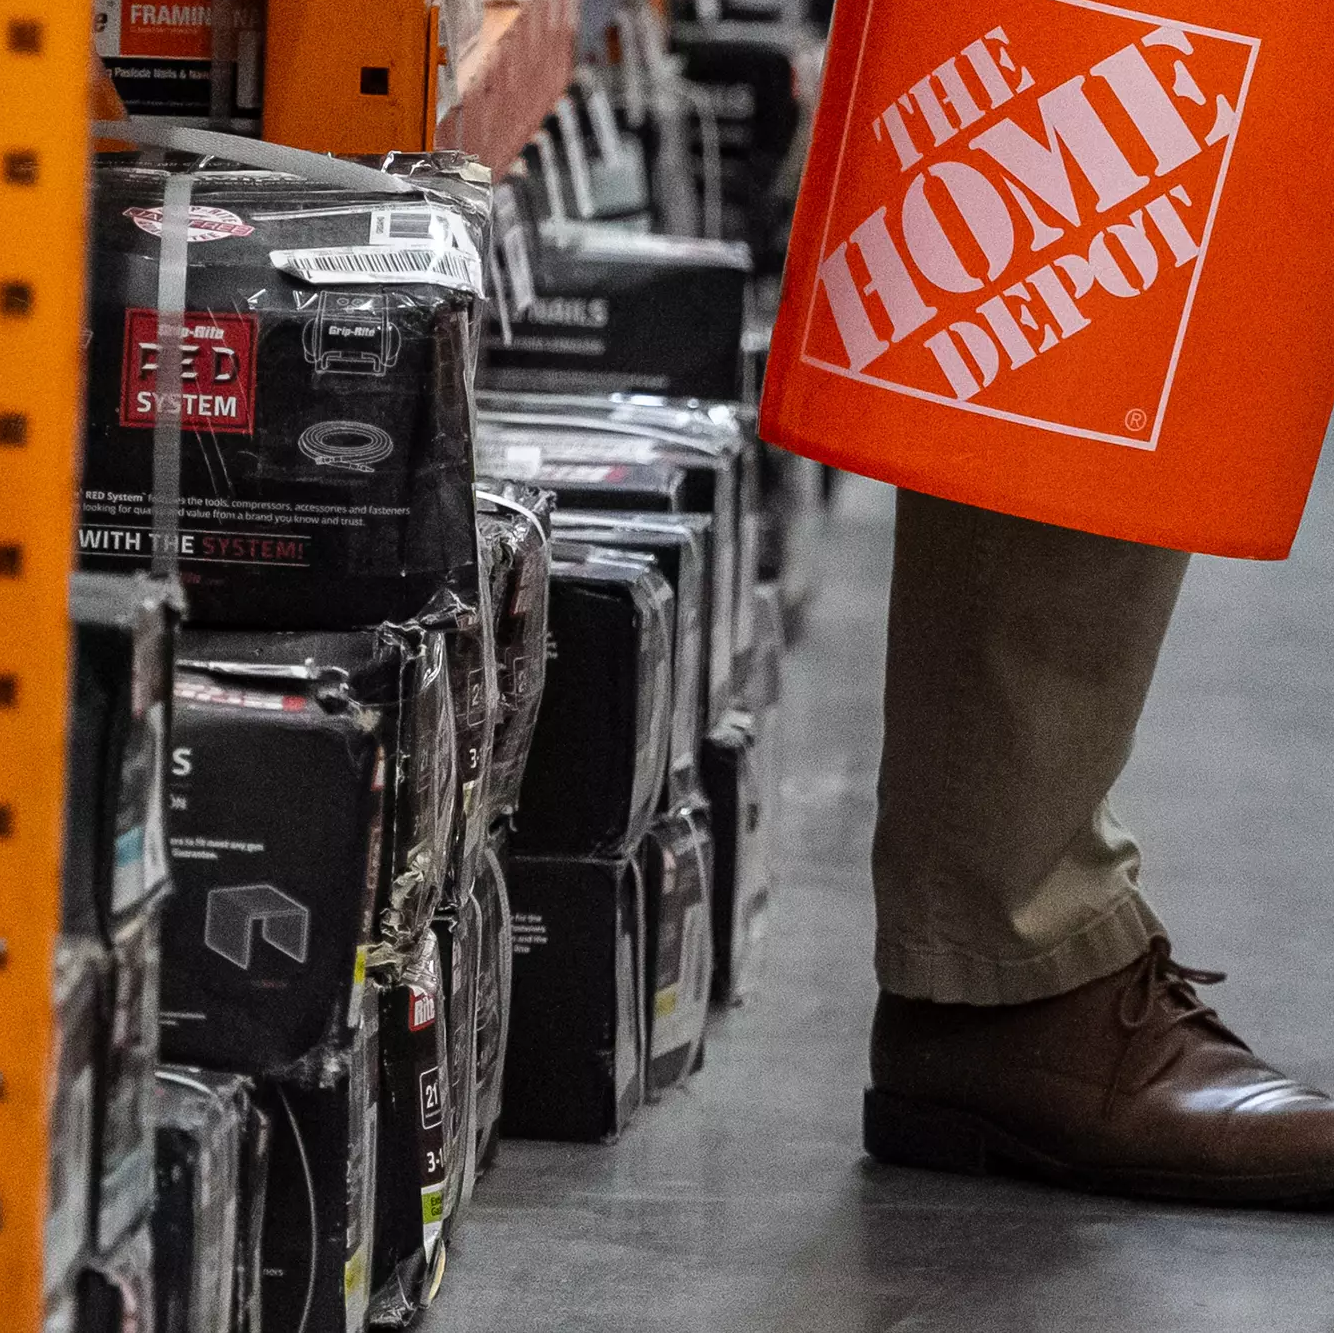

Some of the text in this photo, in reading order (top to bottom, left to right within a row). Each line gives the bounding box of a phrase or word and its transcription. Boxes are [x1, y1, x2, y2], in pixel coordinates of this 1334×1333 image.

[130, 3, 212, 26] FRAMIN
[874, 25, 1035, 172] THE
[817, 24, 1238, 373] HOME
[925, 184, 1204, 403] DEPOT
[329, 325, 376, 337] Grip-Rite
[137, 391, 237, 418] SYSTEM
[85, 491, 105, 500] RED
[188, 497, 203, 506] the
[295, 503, 347, 514] accessories
[348, 505, 367, 514] and
[369, 505, 410, 516] fasteners
[118, 504, 132, 514] for
[186, 509, 211, 519] value
[213, 509, 235, 519] from
[245, 511, 273, 522] brand
[274, 515, 292, 525] you
[294, 514, 318, 524] know
[321, 516, 339, 525] and
[78, 528, 304, 560] WITH THE SYSTEM!
